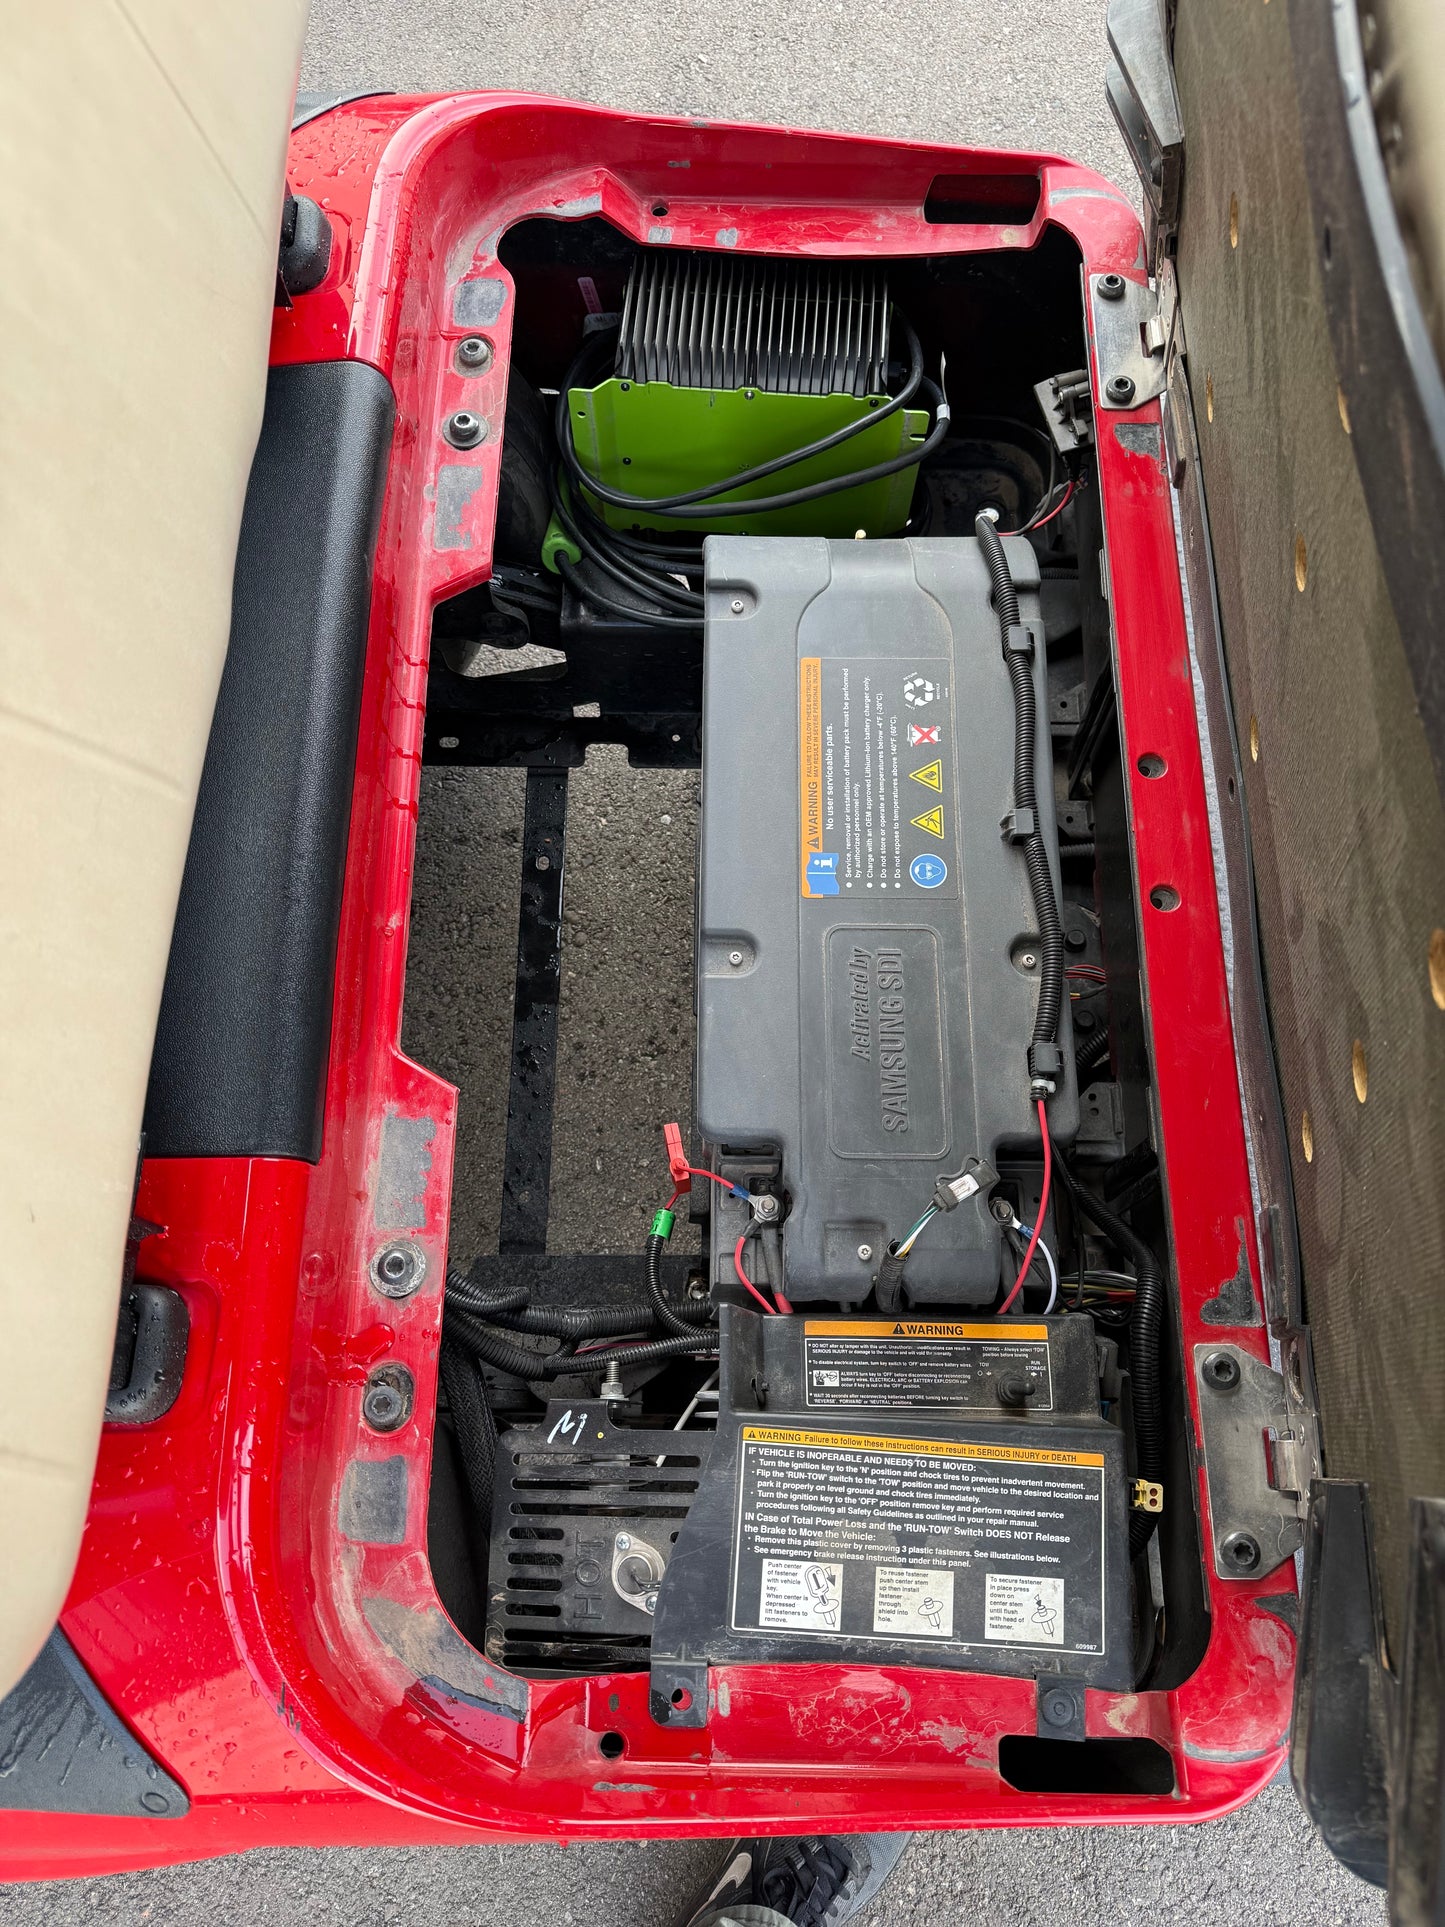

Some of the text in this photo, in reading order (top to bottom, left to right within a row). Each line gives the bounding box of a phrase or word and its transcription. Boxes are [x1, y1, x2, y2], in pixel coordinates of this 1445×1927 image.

[841, 668, 850, 700] performed
[842, 701, 849, 710] be
[863, 692, 871, 716] charger
[825, 723, 834, 746] parts.
[842, 728, 850, 743] pack
[843, 745, 851, 767] battery
[825, 748, 833, 795] serviceable
[843, 768, 850, 776] of
[852, 782, 860, 797] only.
[864, 779, 873, 810] approved
[892, 778, 900, 821] temperatures
[807, 781, 818, 835] WARNING
[852, 798, 861, 831] personnel
[878, 802, 886, 827] operate
[825, 817, 833, 829] No
[867, 828, 872, 837] an
[880, 828, 885, 836] or
[854, 869, 862, 878] by
[866, 853, 874, 878] Charge
[880, 868, 887, 878] Do
[894, 868, 900, 878] Do
[848, 946, 874, 1060] Activated by
[877, 948, 909, 1132] SAMSUNG SDI
[906, 1324, 963, 1335] WARNING
[748, 1446, 976, 1471] IF VEHICLE IS INOPERABLE AND NEEDS TO BE MOVED:
[758, 1431, 801, 1441] WARNING
[885, 1442, 929, 1451] instructions
[976, 1449, 1010, 1457] SERIOUS
[1012, 1451, 1040, 1459] INJURY
[1051, 1453, 1076, 1462] DEATH
[758, 1458, 776, 1466] Turn
[791, 1461, 819, 1470] ignition
[821, 1463, 835, 1472] key
[836, 1464, 844, 1472] to
[845, 1465, 858, 1473] the
[870, 1468, 901, 1476] position
[918, 1470, 941, 1479] chock
[942, 1472, 960, 1481] tires
[1001, 1476, 1043, 1487] inadvertent
[1044, 1481, 1085, 1489] movement.
[757, 1480, 774, 1488] park
[775, 1480, 781, 1488] it
[782, 1482, 814, 1492] properly
[827, 1484, 845, 1492] level
[846, 1487, 874, 1495] ground
[875, 1488, 890, 1496] and
[891, 1489, 914, 1497] chock
[915, 1491, 932, 1499] tires
[934, 1492, 980, 1504] immediately.
[744, 1511, 754, 1520] IN
[756, 1512, 779, 1522] Case
[780, 1514, 790, 1523] of
[791, 1515, 813, 1524] Total
[815, 1516, 843, 1527] Power
[845, 1519, 867, 1528] Loss
[868, 1521, 885, 1530] and
[887, 1522, 902, 1531] the
[954, 1526, 983, 1536] Switch
[985, 1528, 1011, 1538] DOES
[1013, 1530, 1033, 1540] NOT
[1035, 1532, 1070, 1543] Release
[744, 1524, 876, 1541] the Brake to Move the Vehicle:
[754, 1534, 786, 1544] Remove
[786, 1537, 801, 1545] this
[803, 1538, 828, 1547] plastic
[853, 1542, 863, 1551] by
[864, 1544, 900, 1554] removing
[908, 1546, 933, 1554] plastic
[935, 1547, 972, 1557] fasteners.
[973, 1549, 988, 1558] See
[989, 1551, 1034, 1561] illustrations
[1036, 1554, 1060, 1563] below.
[754, 1545, 769, 1553] See
[769, 1548, 812, 1558] emergency
[813, 1550, 835, 1558] brake
[836, 1551, 864, 1560] release
[865, 1553, 906, 1563] instruction
[932, 1557, 946, 1565] this
[948, 1559, 971, 1567] panel.
